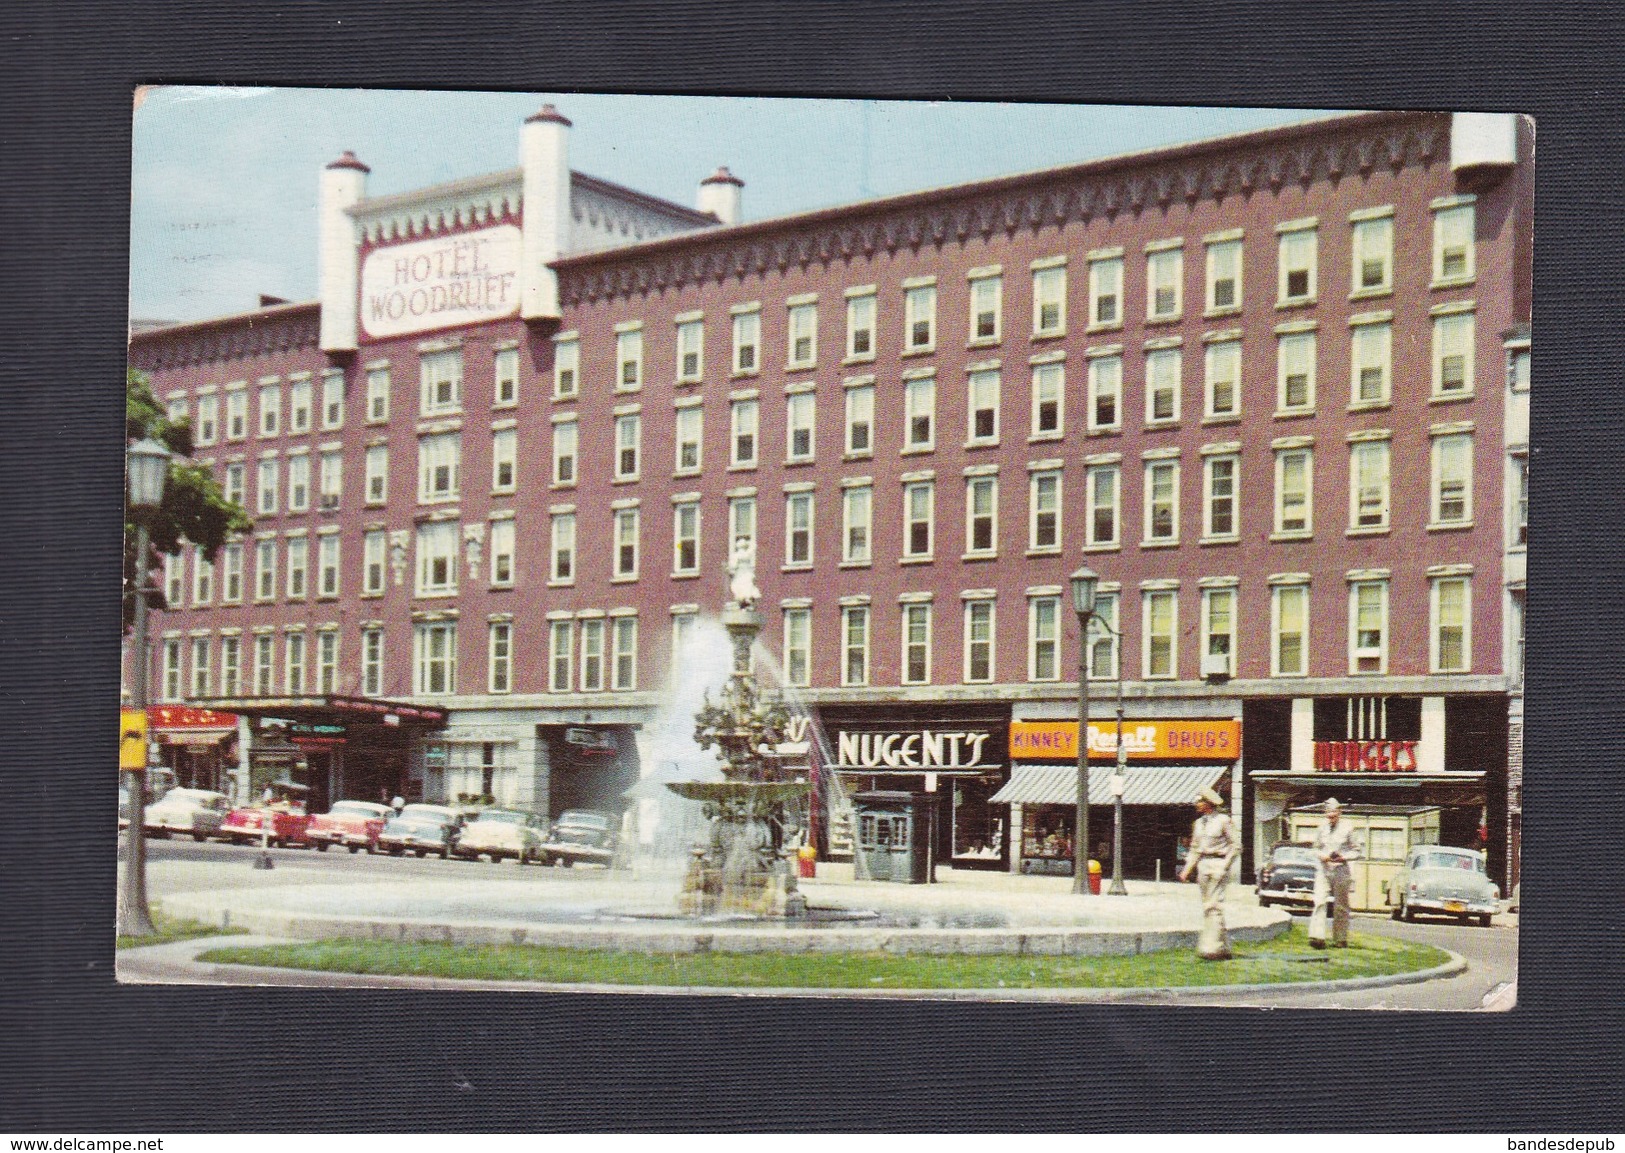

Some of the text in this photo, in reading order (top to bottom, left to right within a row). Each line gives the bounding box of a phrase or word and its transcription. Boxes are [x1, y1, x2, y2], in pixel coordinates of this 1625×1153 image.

[394, 238, 488, 285] HOTEL
[371, 271, 515, 321] WOODRUFF
[839, 730, 990, 766] NUGENT'S
[1014, 732, 1074, 748] KINNEY
[1168, 731, 1230, 748] DRUGS
